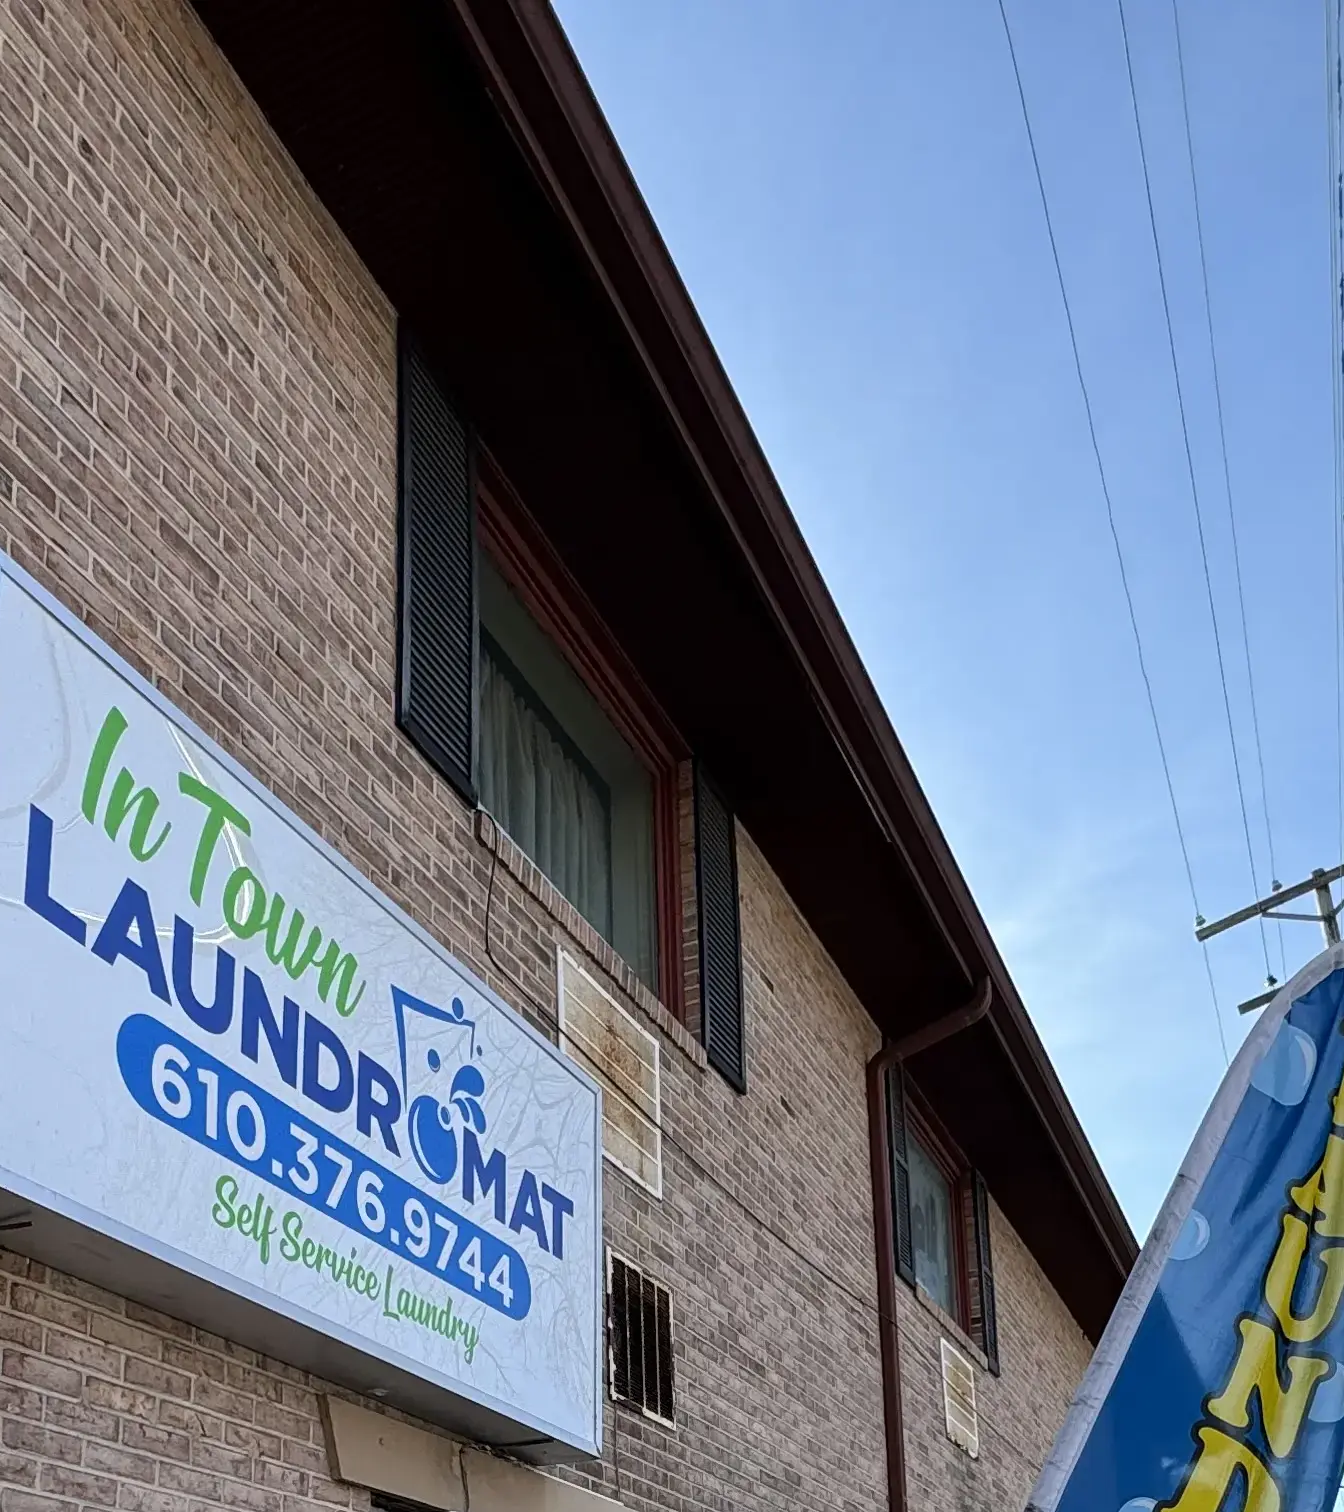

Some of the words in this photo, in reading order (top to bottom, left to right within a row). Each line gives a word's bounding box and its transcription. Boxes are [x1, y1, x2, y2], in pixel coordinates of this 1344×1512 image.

[80, 706, 171, 863] In
[177, 771, 367, 1018] Town
[23, 803, 575, 1260] LAUNDROMAT
[150, 1044, 515, 1310] 610.376.9744
[212, 1174, 277, 1265] Self
[280, 1211, 382, 1302] Service
[383, 1264, 479, 1365] Laundry
